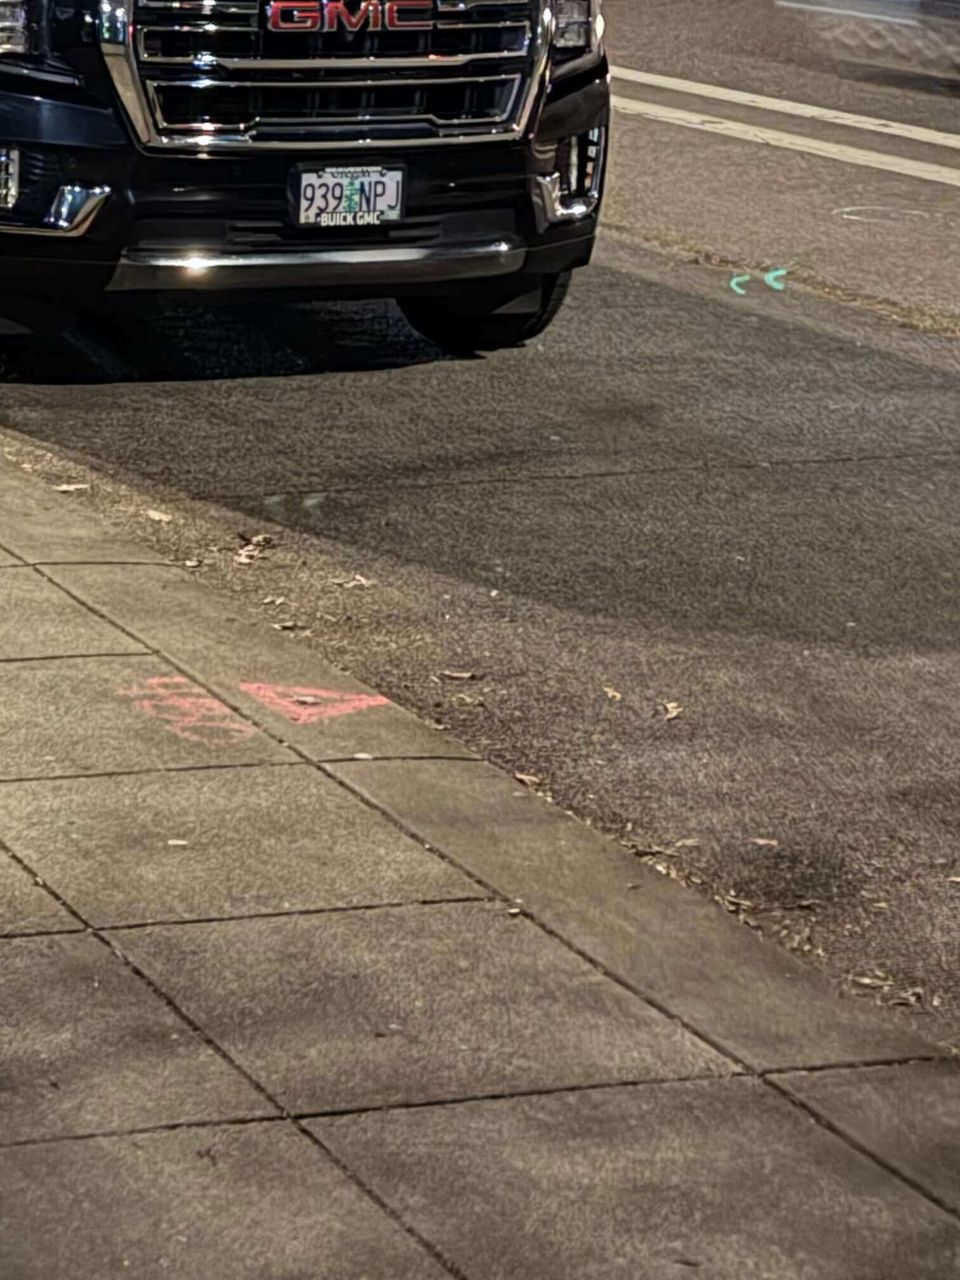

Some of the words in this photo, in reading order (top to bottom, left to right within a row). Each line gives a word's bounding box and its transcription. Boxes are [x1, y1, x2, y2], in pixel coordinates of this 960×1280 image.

[266, 0, 433, 32] GMC
[303, 183, 344, 213] 939
[359, 180, 400, 212] NPJ
[320, 211, 355, 227] BUICK
[356, 211, 381, 225] GMC
